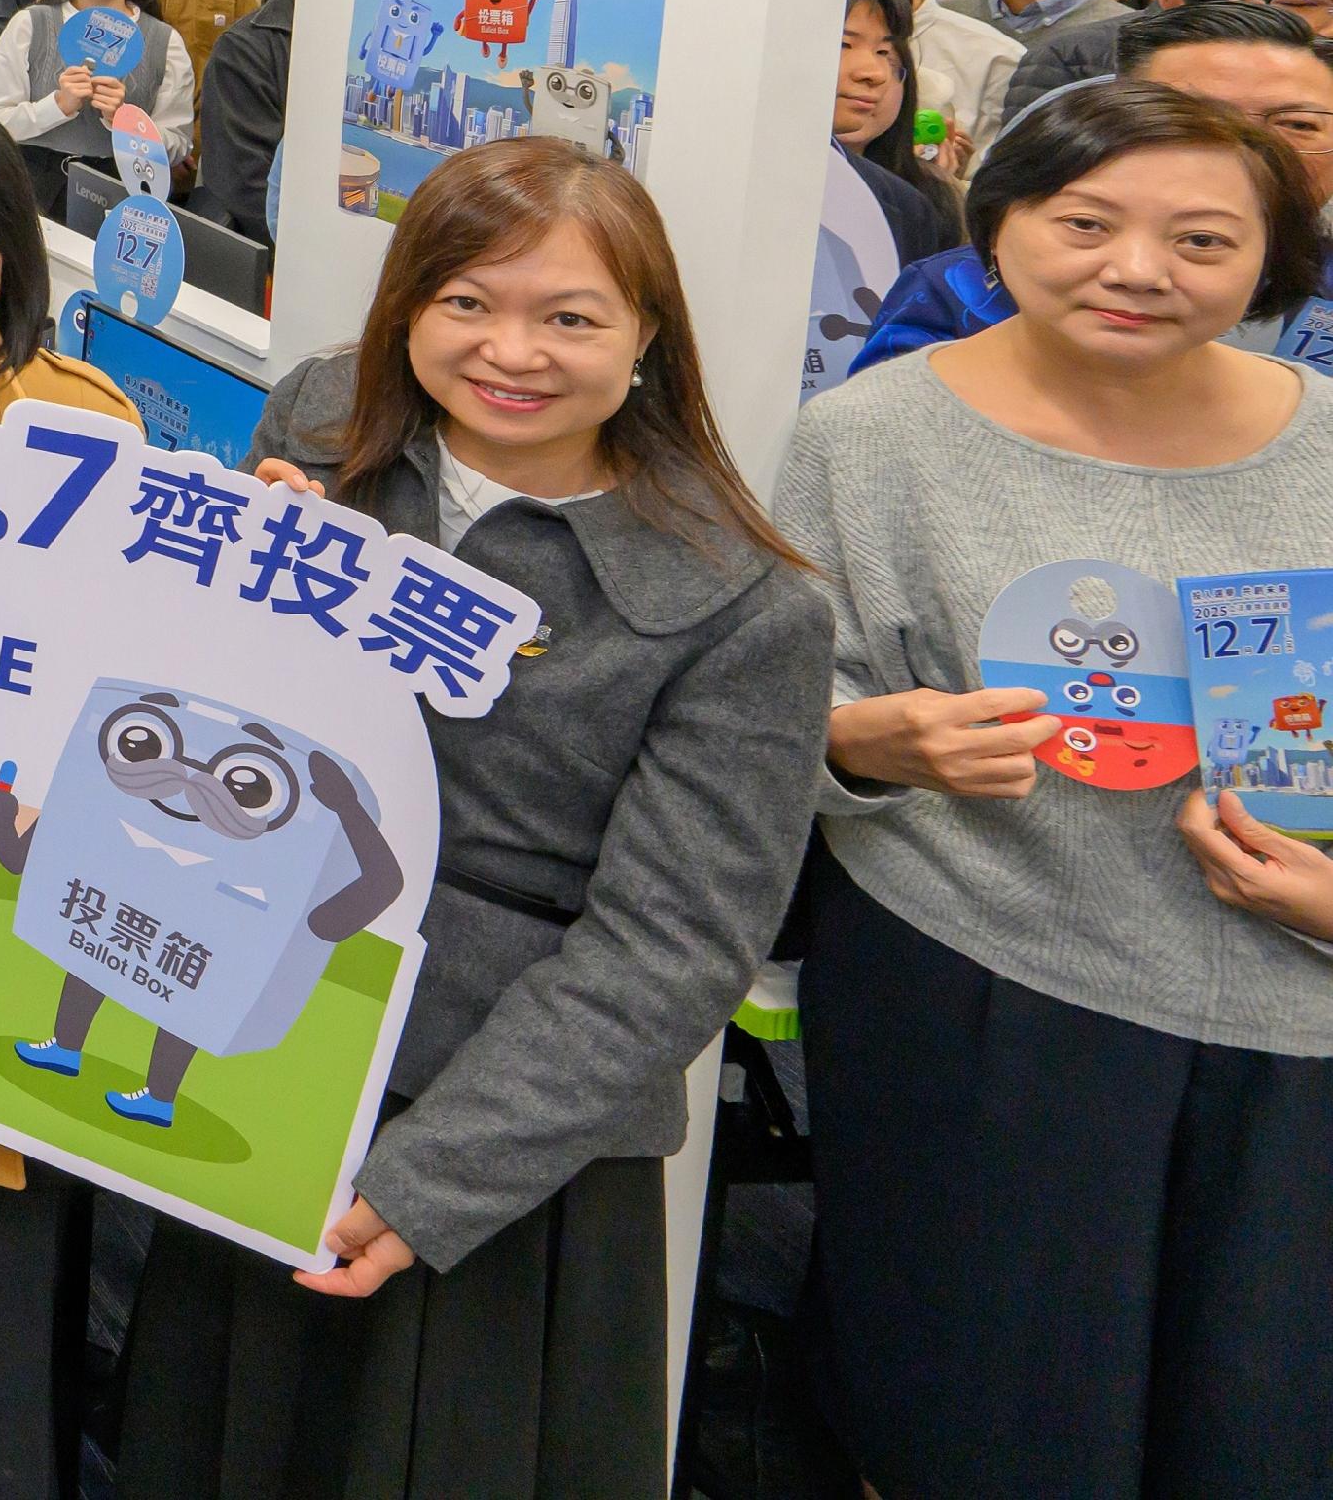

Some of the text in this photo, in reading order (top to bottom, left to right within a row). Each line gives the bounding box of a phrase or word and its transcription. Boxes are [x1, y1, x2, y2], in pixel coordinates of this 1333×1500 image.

[477, 7, 515, 28] 投票箱
[75, 182, 109, 208] Lenovo
[122, 466, 519, 699] 齊投票
[59, 877, 213, 992] 投票箱
[68, 928, 176, 1004] Ballot Box
